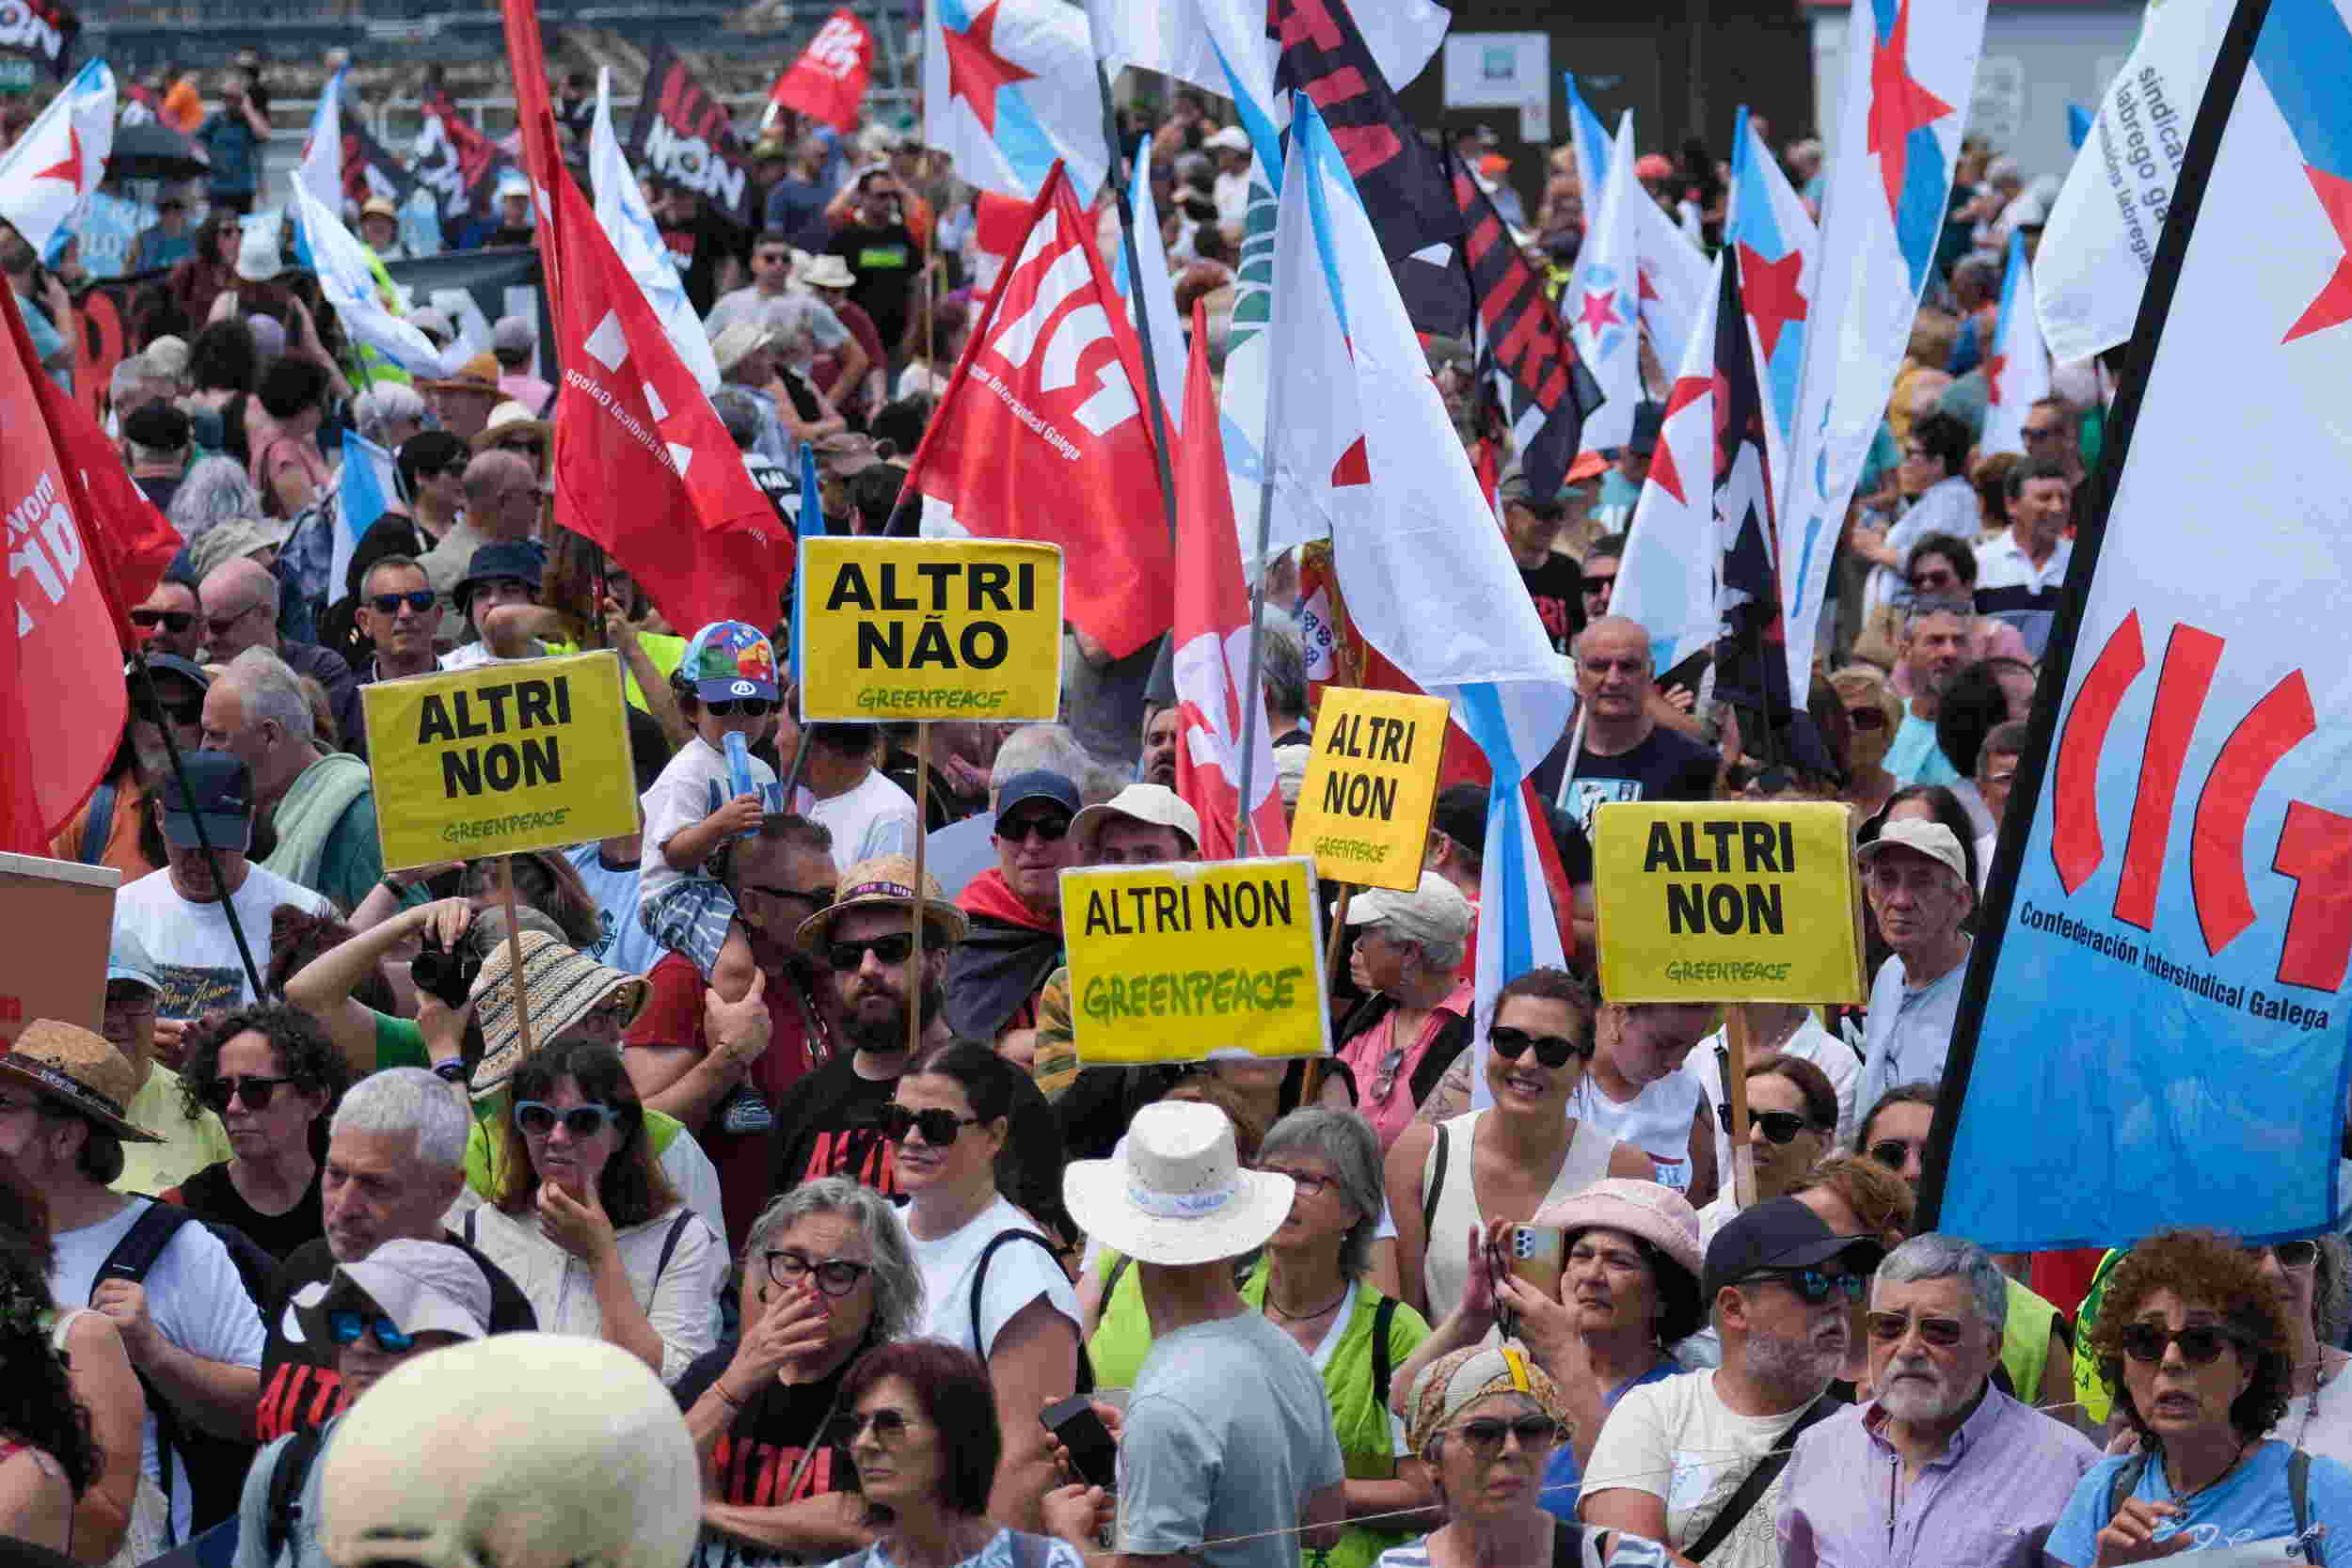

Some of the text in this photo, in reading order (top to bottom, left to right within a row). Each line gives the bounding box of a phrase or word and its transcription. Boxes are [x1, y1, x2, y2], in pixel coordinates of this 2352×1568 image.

[2117, 80, 2156, 180] labrego
[1041, 426, 1082, 462] Galega
[826, 562, 1036, 610] ALTRI
[857, 614, 1009, 670] NÃO
[419, 675, 572, 745] ALTRI
[857, 688, 1009, 710] GREENPEACE
[1326, 713, 1415, 765] ALTRI
[441, 736, 562, 799] NON
[1323, 770, 1398, 821] NON
[443, 806, 572, 844] GREENPEACE
[1315, 836, 1390, 863] GREENPEACE
[1644, 821, 1795, 873] ALTRI
[1085, 879, 1293, 937] ALTRI NON
[1666, 883, 1785, 935] NON
[1665, 960, 1792, 984] GREENPEACE
[2020, 900, 2138, 965] Confederación
[2249, 990, 2329, 1031] Galega
[1082, 964, 1303, 1027] GREENPEACE
